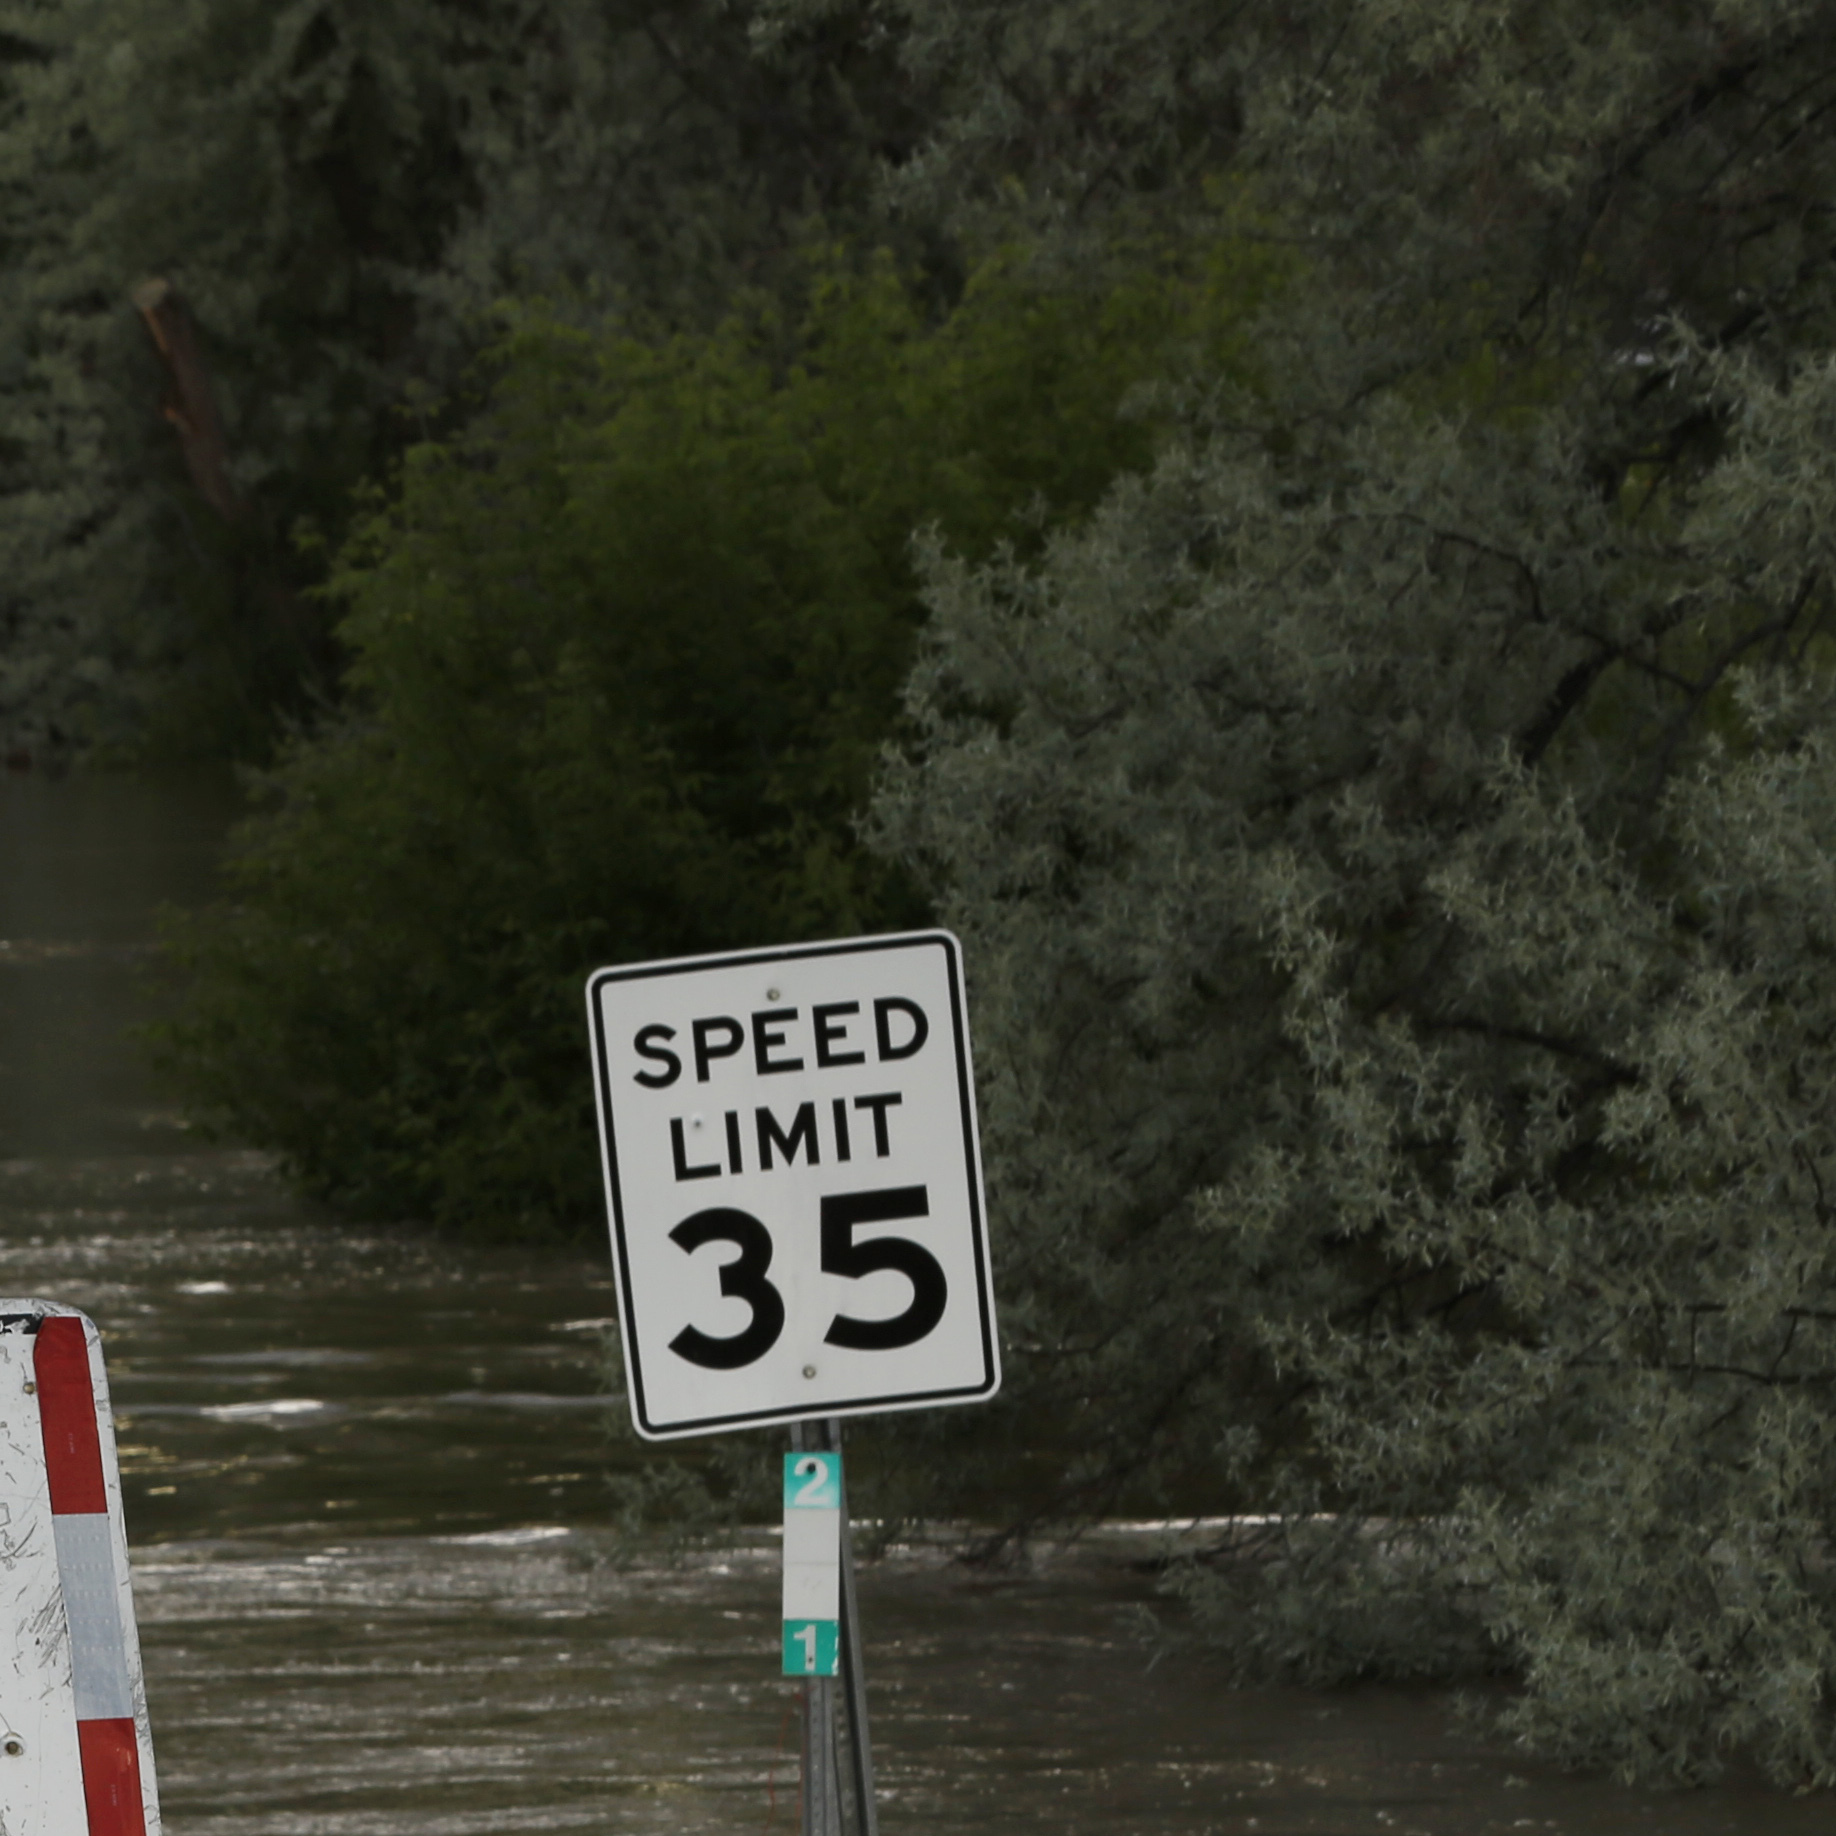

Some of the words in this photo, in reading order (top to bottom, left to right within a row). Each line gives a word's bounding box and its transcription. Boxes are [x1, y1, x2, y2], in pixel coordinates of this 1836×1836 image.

[632, 996, 930, 1090] SPEED
[669, 1092, 904, 1183] LIMIT
[667, 1184, 949, 1371] 35
[793, 1457, 830, 1506] 2
[792, 1624, 818, 1672] 1
